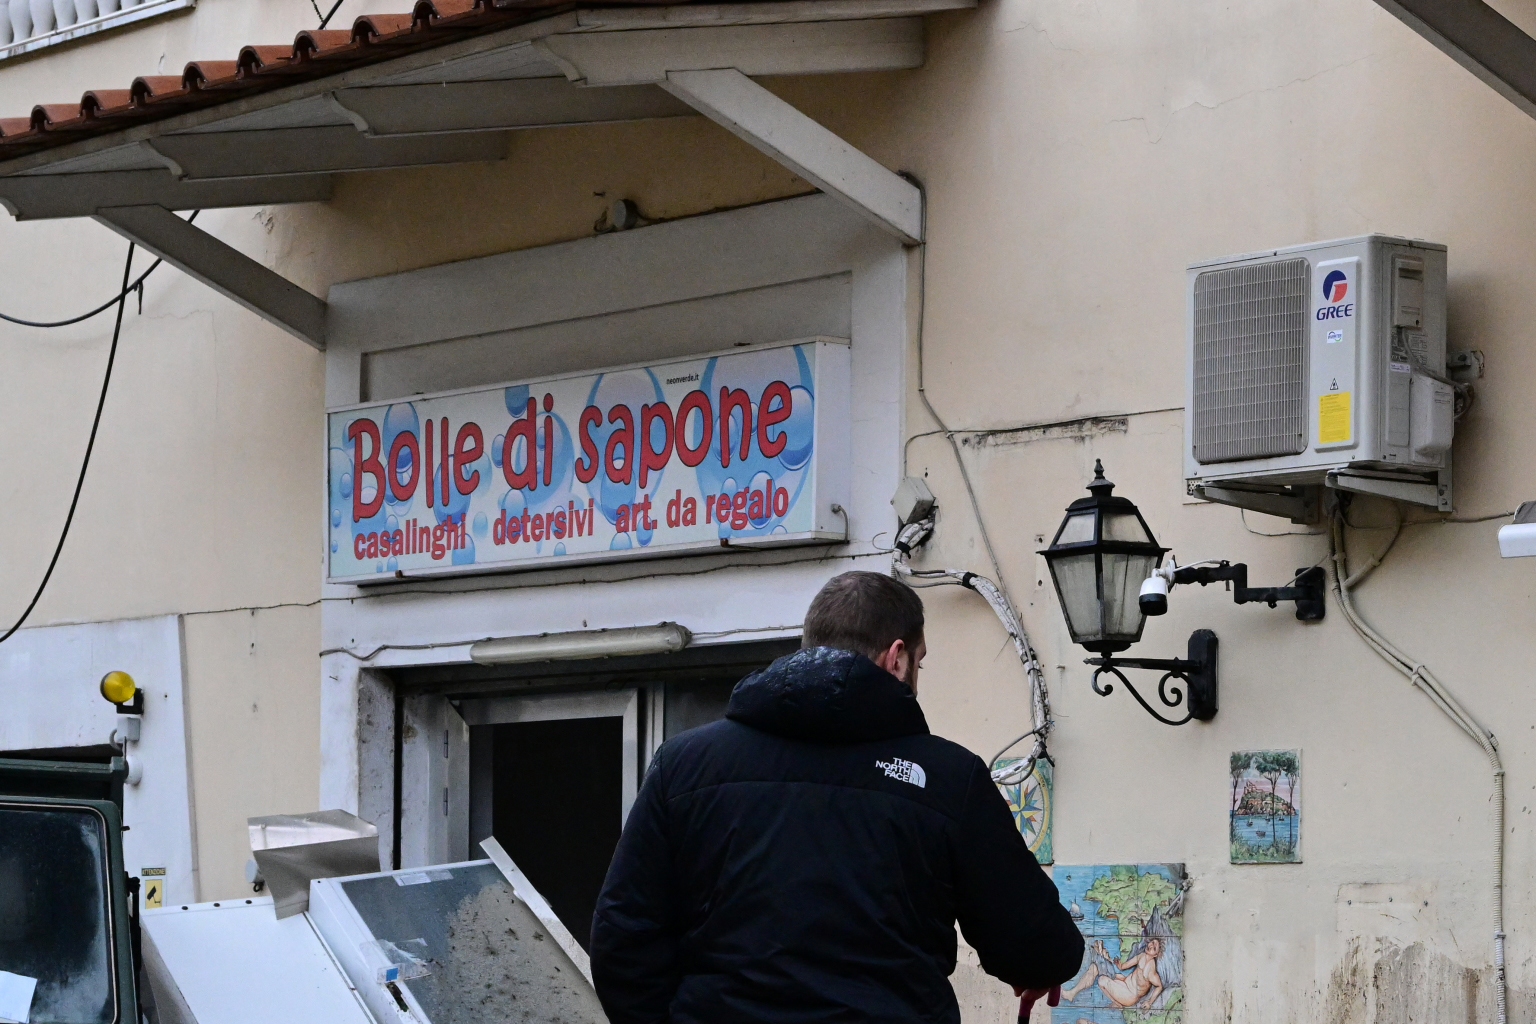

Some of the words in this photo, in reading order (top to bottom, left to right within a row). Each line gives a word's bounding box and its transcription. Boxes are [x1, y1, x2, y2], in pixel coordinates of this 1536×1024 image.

[1316, 303, 1354, 321] GREE
[348, 415, 484, 522] Bolle
[502, 393, 555, 491] di
[575, 380, 794, 489] sapone
[353, 514, 467, 560] casalinghi
[493, 498, 594, 546] detersivi
[615, 500, 658, 534] art.
[666, 490, 698, 529] da
[705, 479, 790, 530] regalo
[875, 760, 911, 776] NORTH
[893, 757, 912, 768] THE
[884, 769, 909, 783] FACE
